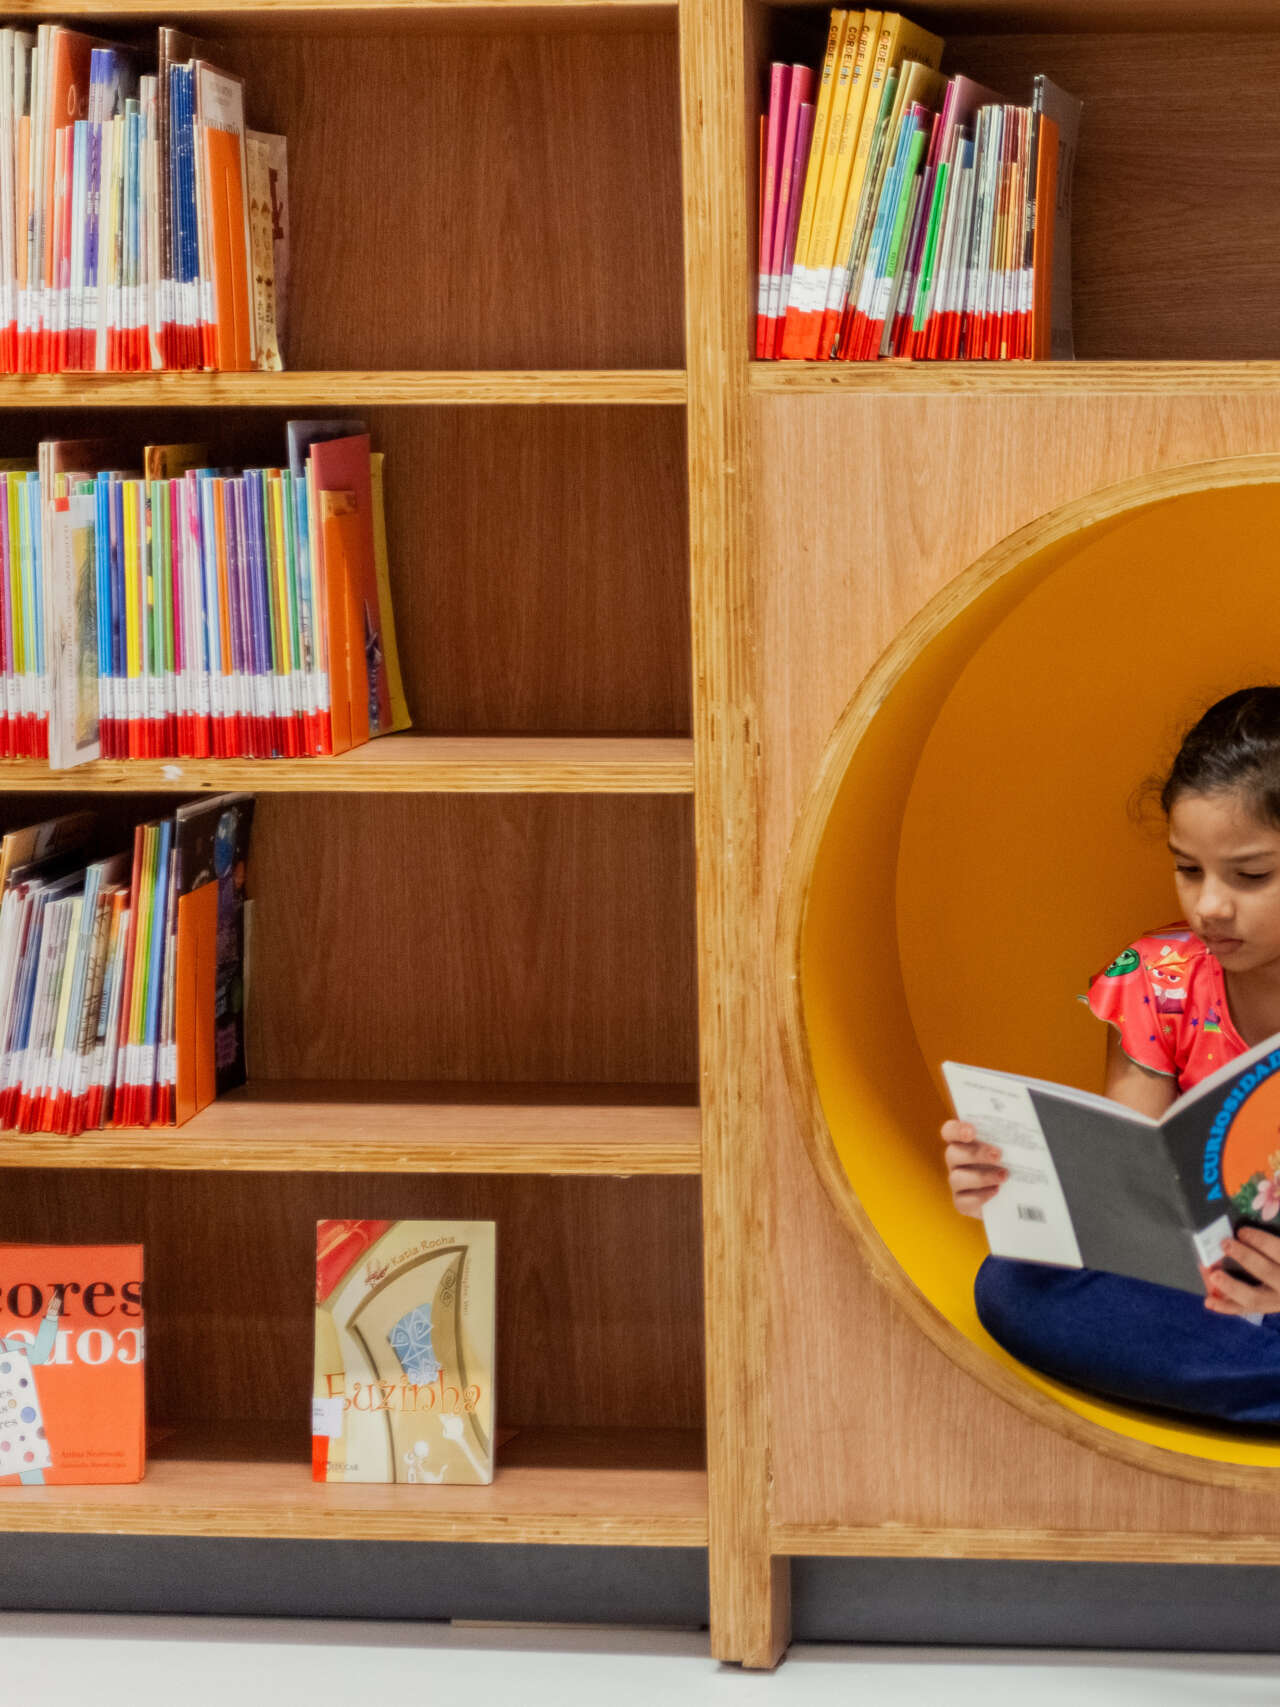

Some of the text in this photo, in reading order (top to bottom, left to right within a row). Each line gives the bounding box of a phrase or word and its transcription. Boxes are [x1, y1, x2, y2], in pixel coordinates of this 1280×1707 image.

[1207, 1186, 1223, 1201] A
[421, 1236, 456, 1251] Rocha
[0, 1281, 144, 1318] ores
